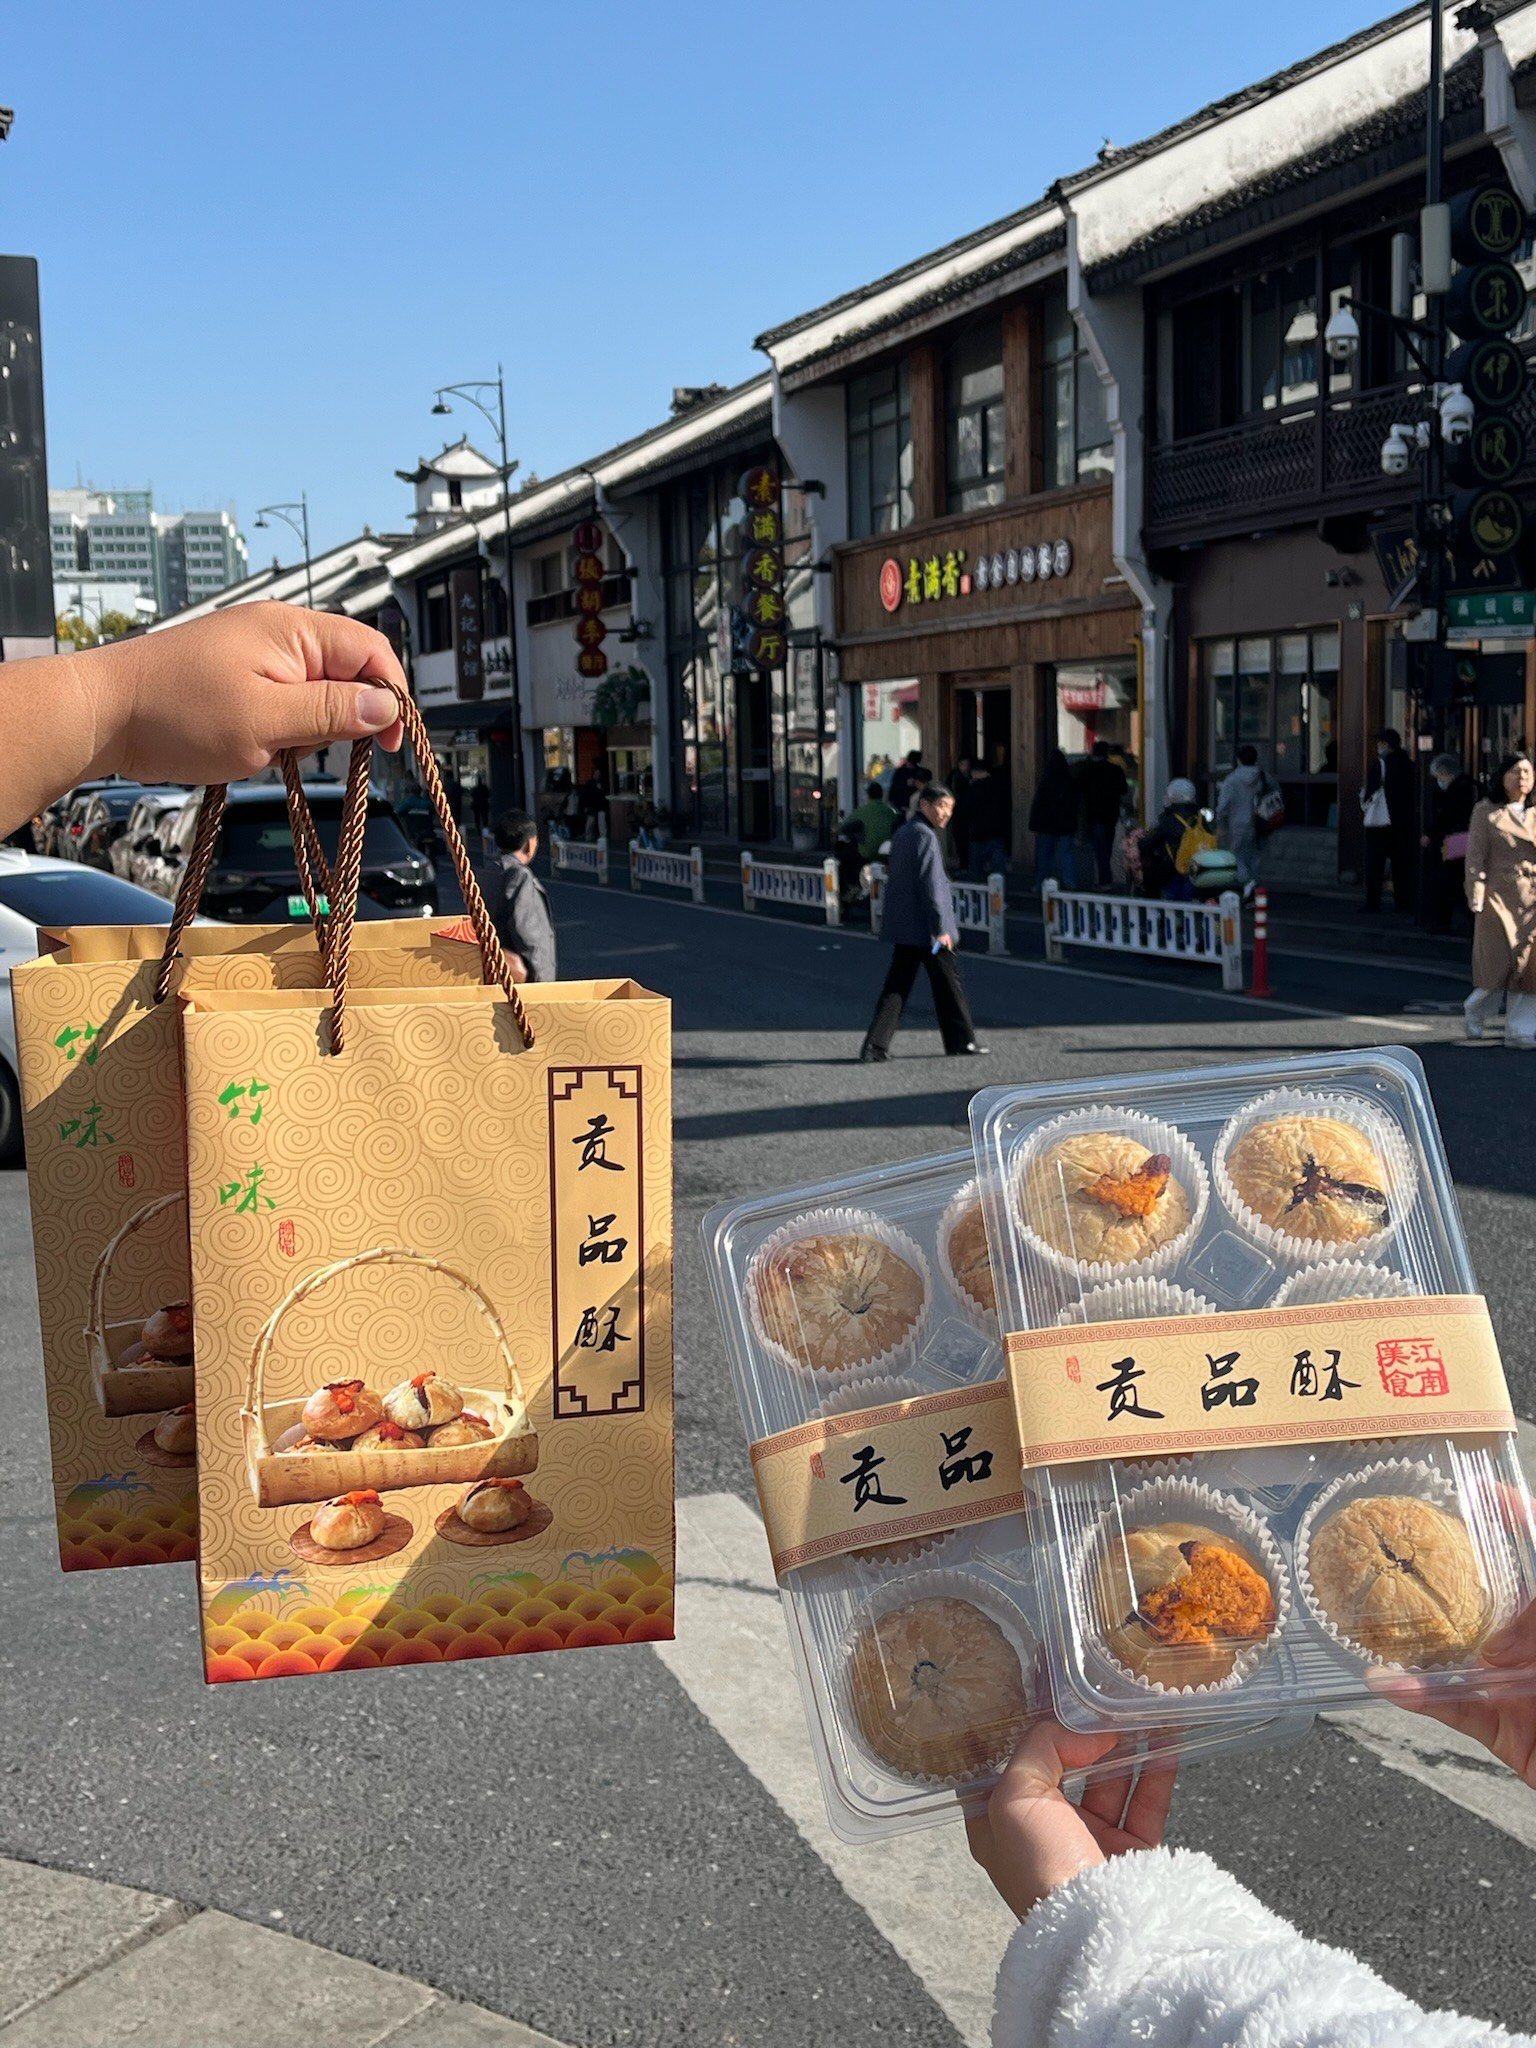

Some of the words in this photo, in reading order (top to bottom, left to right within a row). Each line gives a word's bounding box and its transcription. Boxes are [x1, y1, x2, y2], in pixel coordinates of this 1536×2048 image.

[749, 471, 782, 661] 素满香餐厅
[905, 551, 961, 604] 素满香
[55, 1022, 116, 1150] 竹味
[217, 1077, 276, 1216] 竹味
[571, 1114, 632, 1355] 贡品酥
[1095, 1347, 1362, 1421] 贡品酥
[838, 1427, 994, 1513] 贡品
